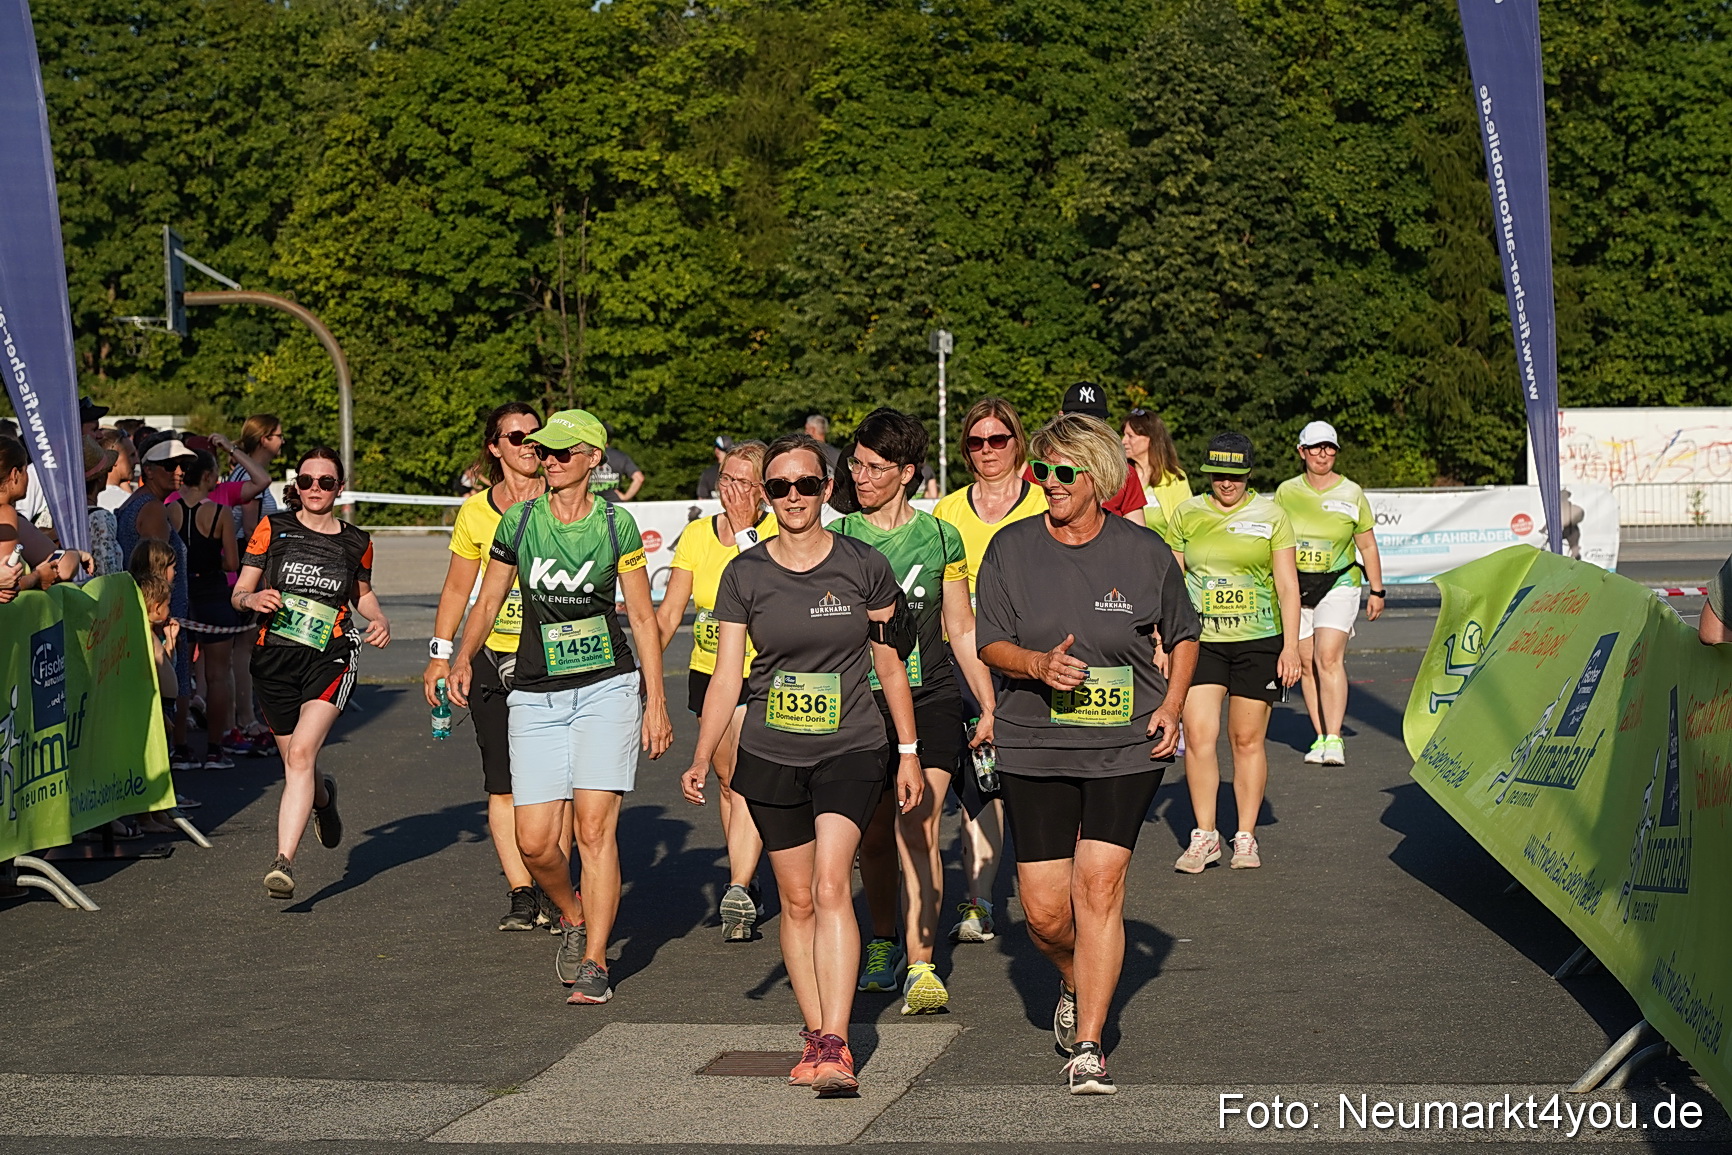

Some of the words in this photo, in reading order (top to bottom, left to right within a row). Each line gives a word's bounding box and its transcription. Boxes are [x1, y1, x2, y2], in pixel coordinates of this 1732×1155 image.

[1434, 528, 1513, 544] FAHRRÄDER
[1300, 551, 1322, 562] 215
[282, 561, 324, 576] HECK
[285, 573, 342, 592] DESIGN
[548, 595, 592, 605] ENERGIE
[1094, 601, 1133, 611] BURKHARDT
[1215, 590, 1244, 604] 826
[810, 605, 851, 615] BURKHARDT
[287, 609, 324, 634] 1742
[500, 618, 521, 629] Ruppert
[319, 624, 332, 645] 2022
[555, 635, 603, 658] 1452
[601, 636, 612, 660] 2022
[547, 647, 557, 666] RUN
[558, 657, 581, 666] Grimm
[581, 653, 603, 663] Sabine
[910, 655, 919, 680] 2022
[768, 691, 776, 720] WALK
[776, 691, 828, 714] 1336
[1066, 687, 1121, 707] 1335
[1121, 690, 1130, 718] 2022
[775, 711, 804, 722] Domeier
[828, 697, 837, 725] 2022
[1100, 708, 1123, 716] Beate
[1521, 727, 1605, 791] firmenlauf
[1505, 786, 1541, 808] neumarkt
